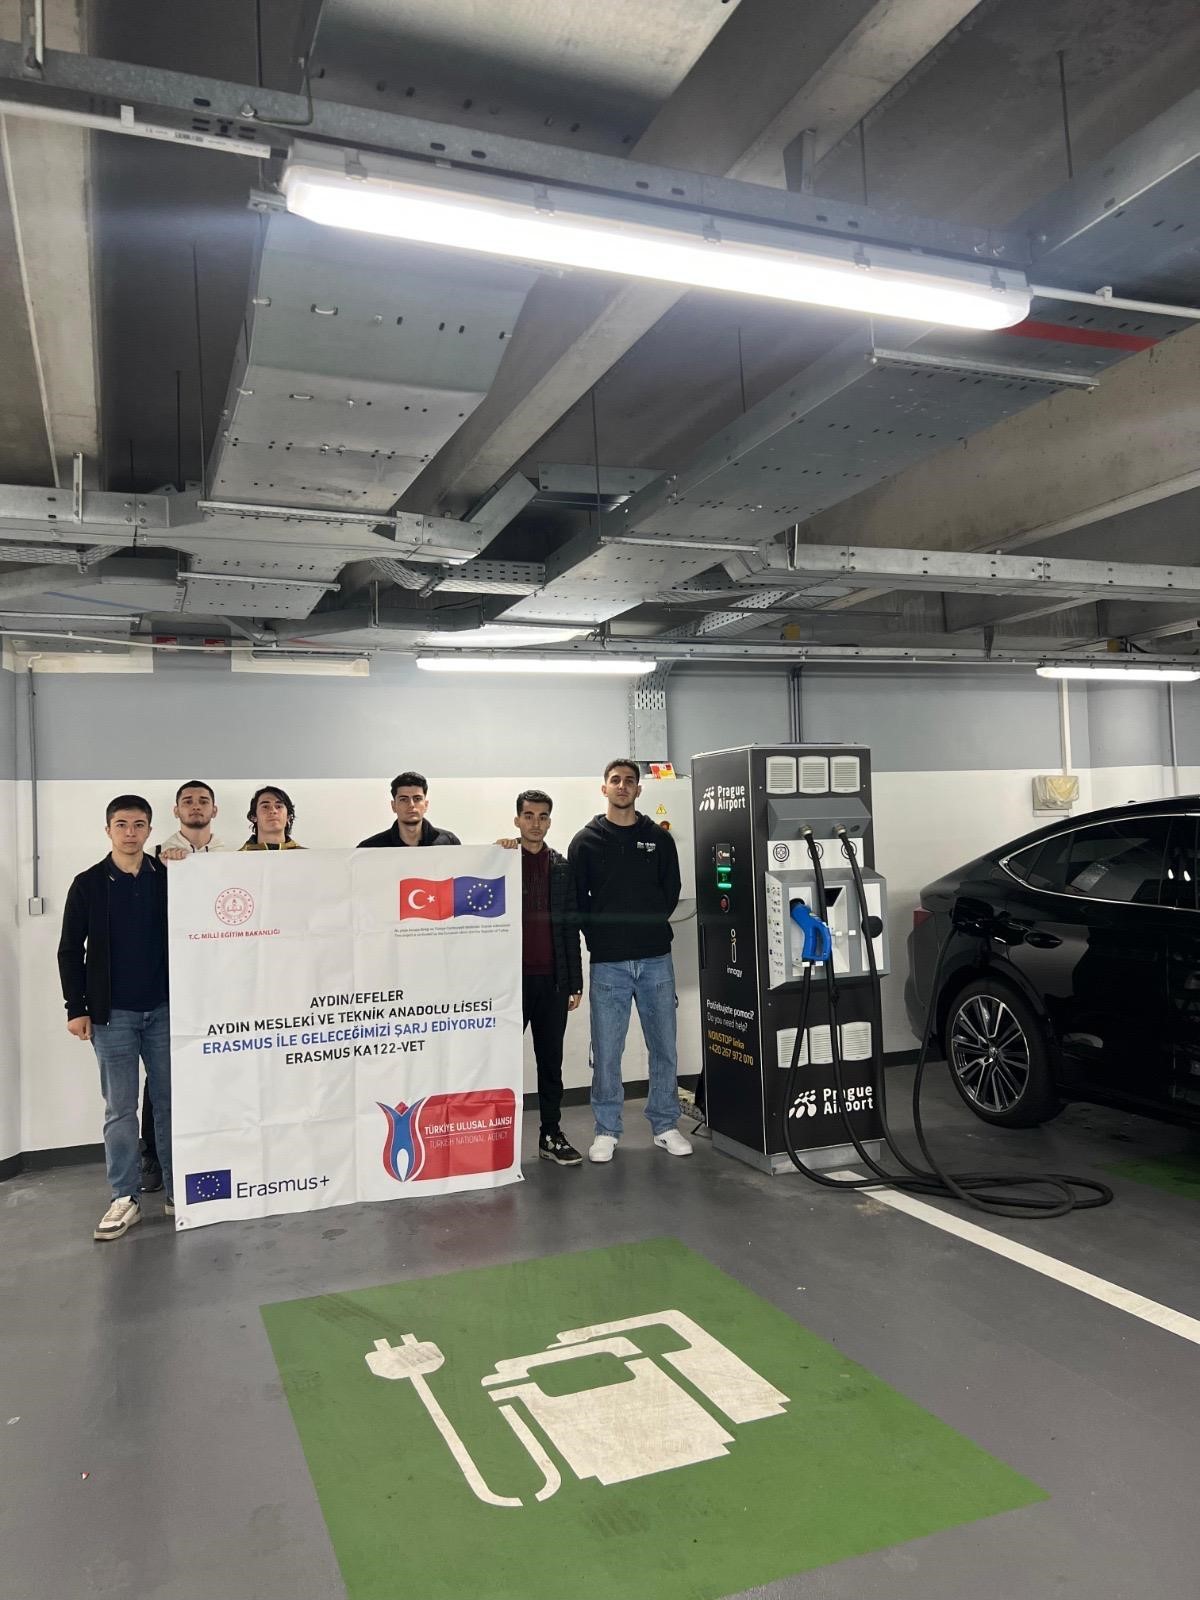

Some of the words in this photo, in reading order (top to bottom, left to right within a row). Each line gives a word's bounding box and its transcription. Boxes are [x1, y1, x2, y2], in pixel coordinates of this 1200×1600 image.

[717, 785, 745, 799] Prague
[717, 797, 746, 812] Airport
[245, 928, 281, 938] BAKANLIĞI
[309, 989, 404, 1009] AYDIN/EFELER
[207, 1020, 250, 1036] AYDIN
[254, 1012, 315, 1031] MESLEKİ
[317, 1013, 335, 1026] VE
[338, 1006, 385, 1024] TEKNİK
[388, 1003, 450, 1019] ANADOLU
[453, 998, 493, 1014] LİSESİ
[202, 1037, 273, 1055] ERASMUS
[276, 1033, 298, 1048] İLE
[301, 1022, 391, 1045] GELECEĞİMİZİ
[394, 1022, 428, 1037] ŞARJ
[431, 1015, 497, 1033] EDİYORUZ!
[285, 1047, 350, 1065] ERASMUS
[353, 1039, 426, 1057] KA122-VET
[823, 1085, 873, 1102] Prgue
[424, 1122, 455, 1136] TÜRKİYE
[456, 1118, 487, 1132] ULUSAL
[488, 1115, 513, 1128] AJANSI
[236, 1175, 331, 1199] Erasmus+
